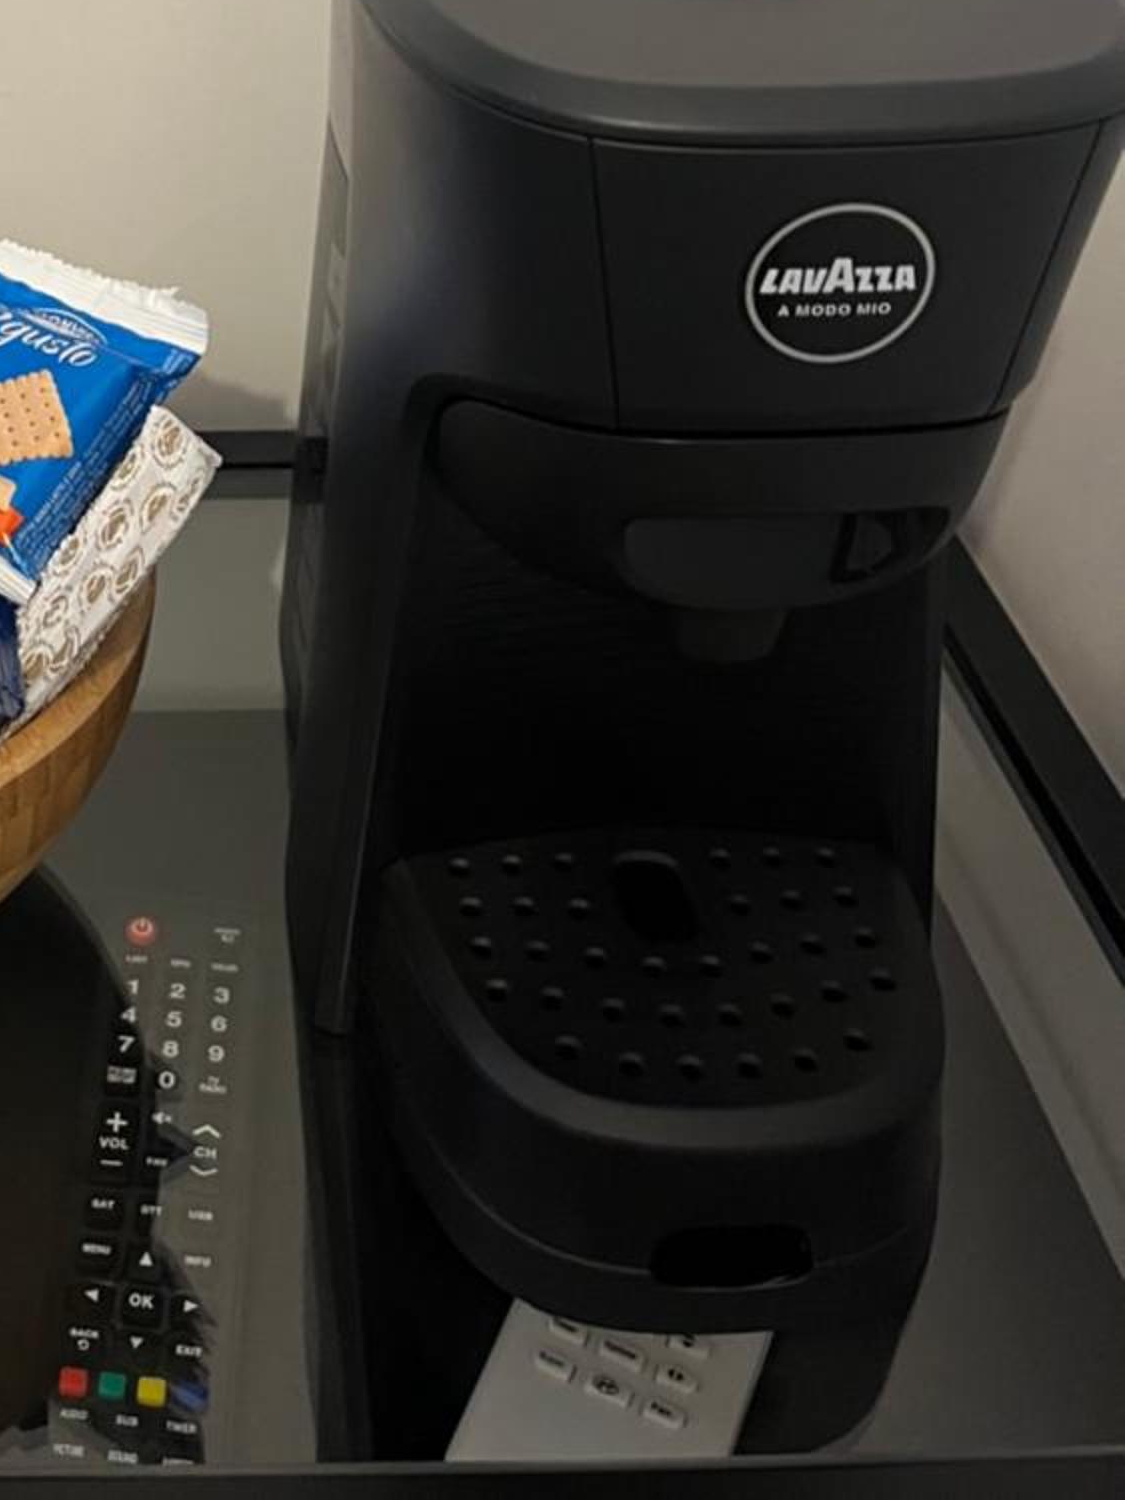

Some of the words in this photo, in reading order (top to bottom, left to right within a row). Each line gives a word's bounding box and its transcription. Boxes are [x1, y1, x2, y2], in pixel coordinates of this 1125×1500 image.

[759, 257, 916, 294] LAVAZZA
[777, 304, 789, 317] A
[795, 303, 851, 317] MODO
[856, 301, 891, 315] MIO
[126, 979, 139, 995] 1
[169, 982, 186, 999] 2
[213, 986, 230, 1004] 3
[120, 1007, 136, 1023] 4
[165, 1010, 182, 1028] 5
[210, 1015, 228, 1032] 6
[118, 1035, 135, 1053] 7
[162, 1040, 179, 1058] 8
[208, 1045, 225, 1062] 9
[158, 1071, 175, 1089] 0
[99, 1136, 129, 1150] VOL
[193, 1146, 217, 1160] CH
[128, 1293, 154, 1309] OK
[175, 1344, 202, 1357] EXIT
